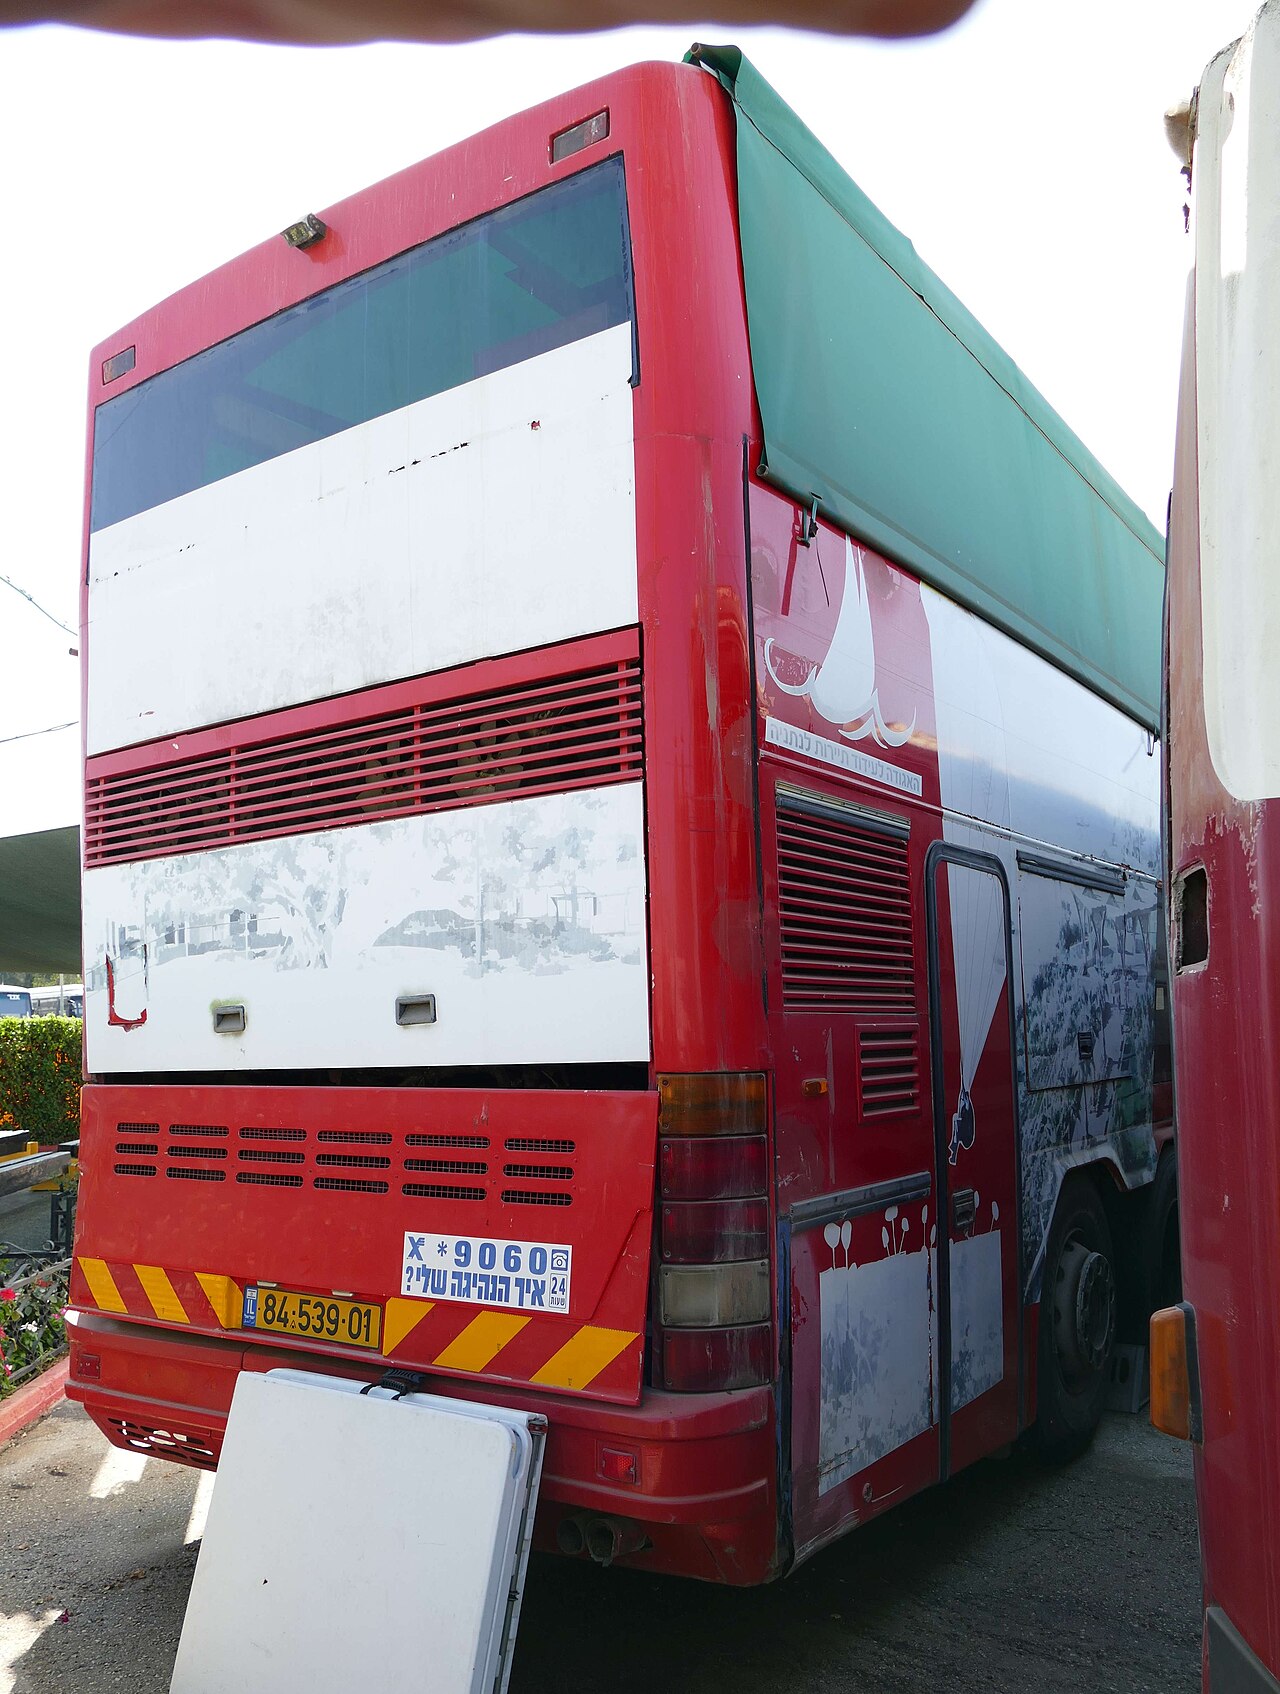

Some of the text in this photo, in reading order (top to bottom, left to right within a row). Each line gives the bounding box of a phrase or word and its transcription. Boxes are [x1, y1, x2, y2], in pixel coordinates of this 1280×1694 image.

[770, 723, 920, 792] האגודה לעידוד תיירות לנתניה
[405, 1264, 546, 1307] איך הנהיגה שלי?
[551, 1276, 566, 1296] 24
[550, 1296, 566, 1307] שעות
